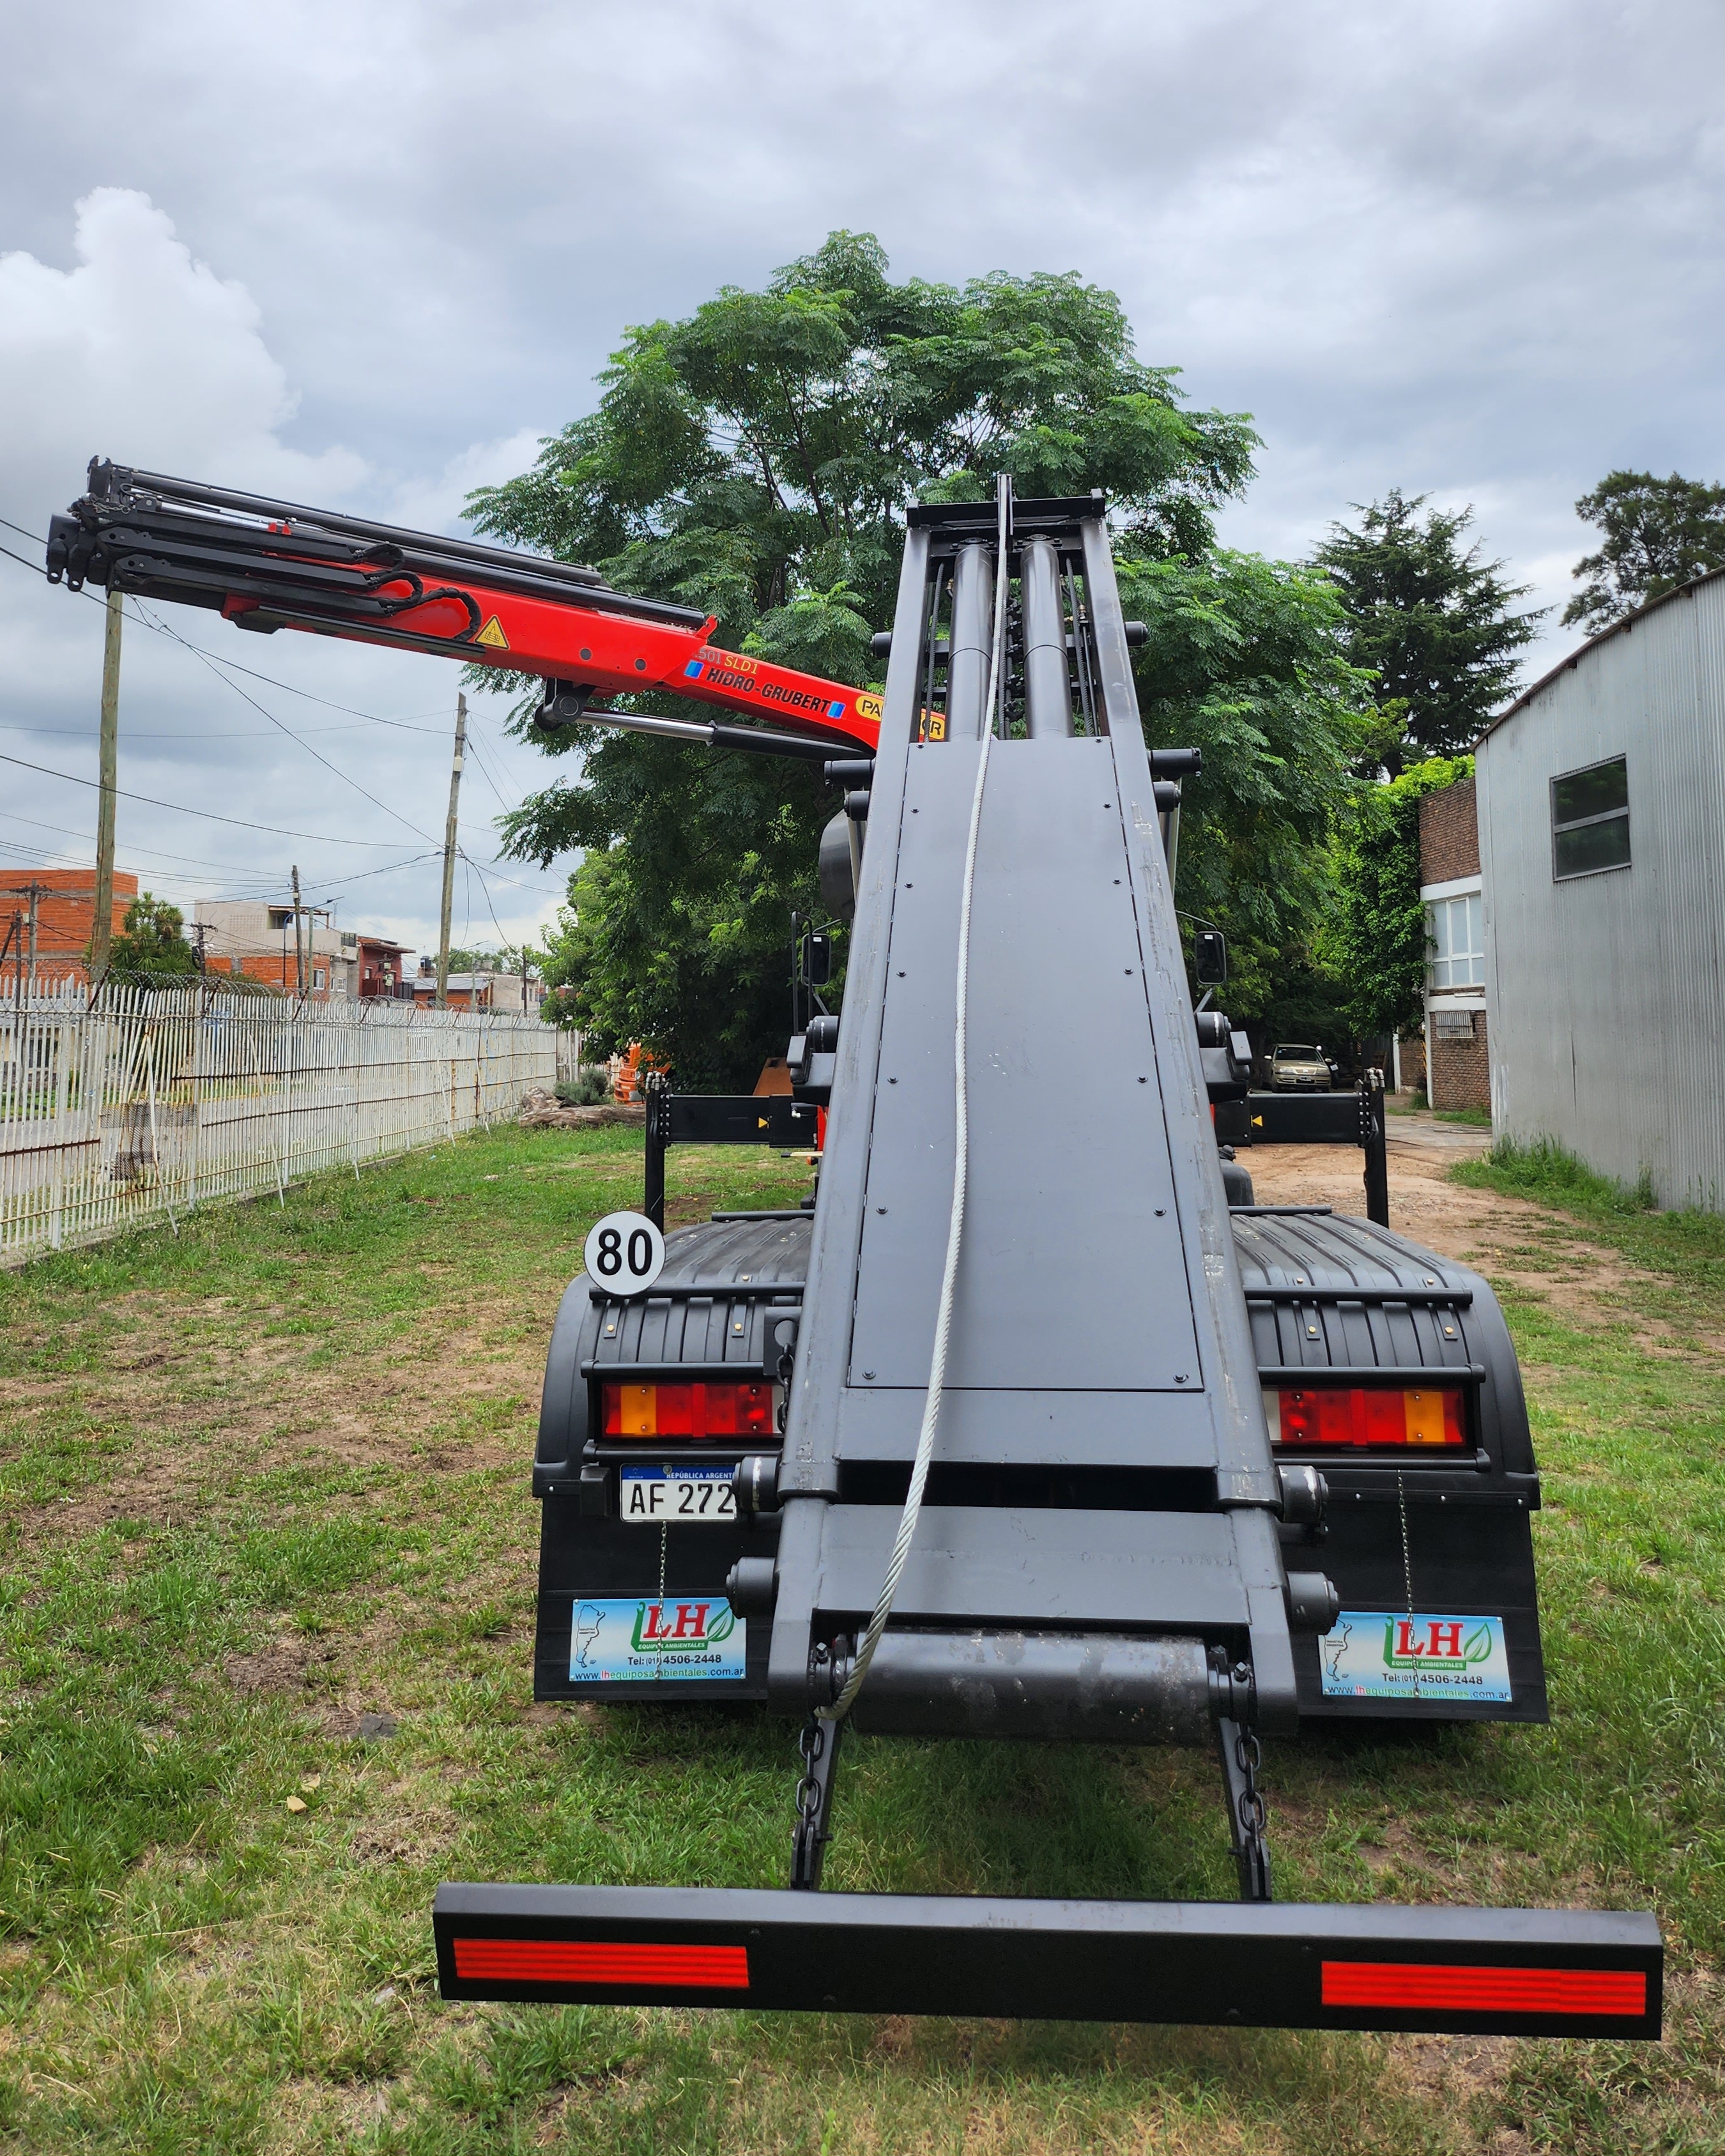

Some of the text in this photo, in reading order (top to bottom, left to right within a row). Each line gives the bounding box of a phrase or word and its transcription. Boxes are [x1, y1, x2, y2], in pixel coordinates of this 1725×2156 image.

[693, 648, 758, 674] 501 SLD1
[597, 1228, 653, 1276] 80
[666, 1471, 704, 1479] REPÚBLICA
[629, 1483, 734, 1513] AF 272
[643, 1603, 710, 1639] LH
[1395, 1621, 1464, 1656] LH
[628, 1656, 644, 1665] Tel:
[663, 1654, 722, 1664] 4506-2448
[1382, 1672, 1400, 1682] Tel:
[1420, 1674, 1483, 1685] 4506-2448
